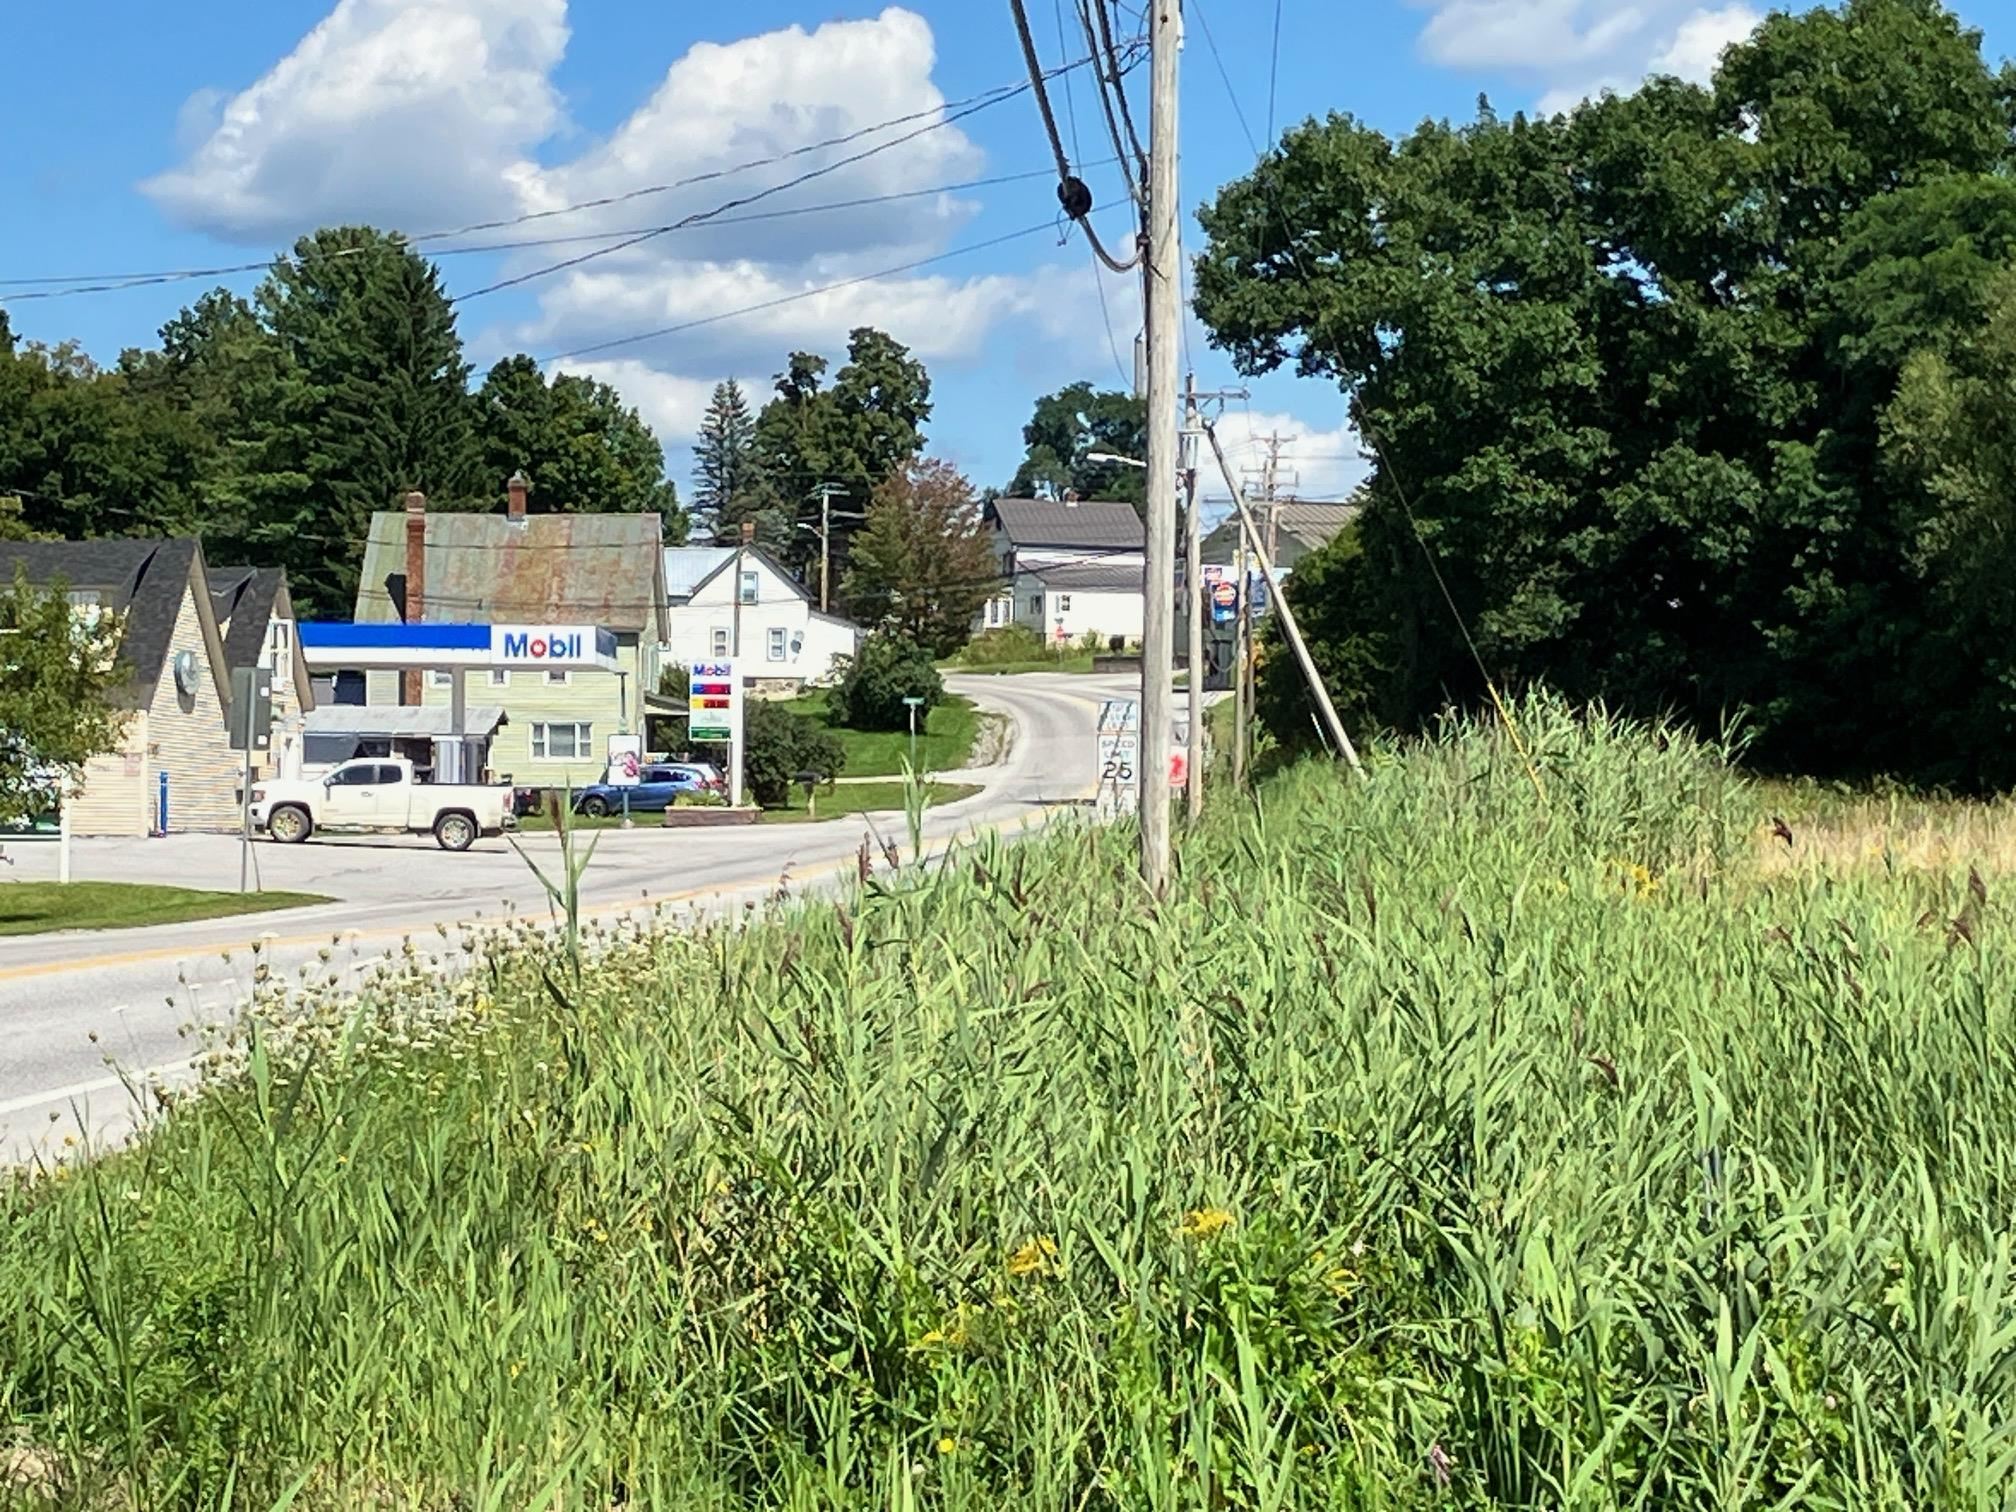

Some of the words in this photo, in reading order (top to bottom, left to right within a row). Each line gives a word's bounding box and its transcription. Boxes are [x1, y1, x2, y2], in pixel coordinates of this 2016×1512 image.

[504, 633, 581, 658] Mobil
[693, 663, 731, 676] Mobil
[1104, 750, 1130, 758] LIT
[1102, 761, 1132, 780] 25
